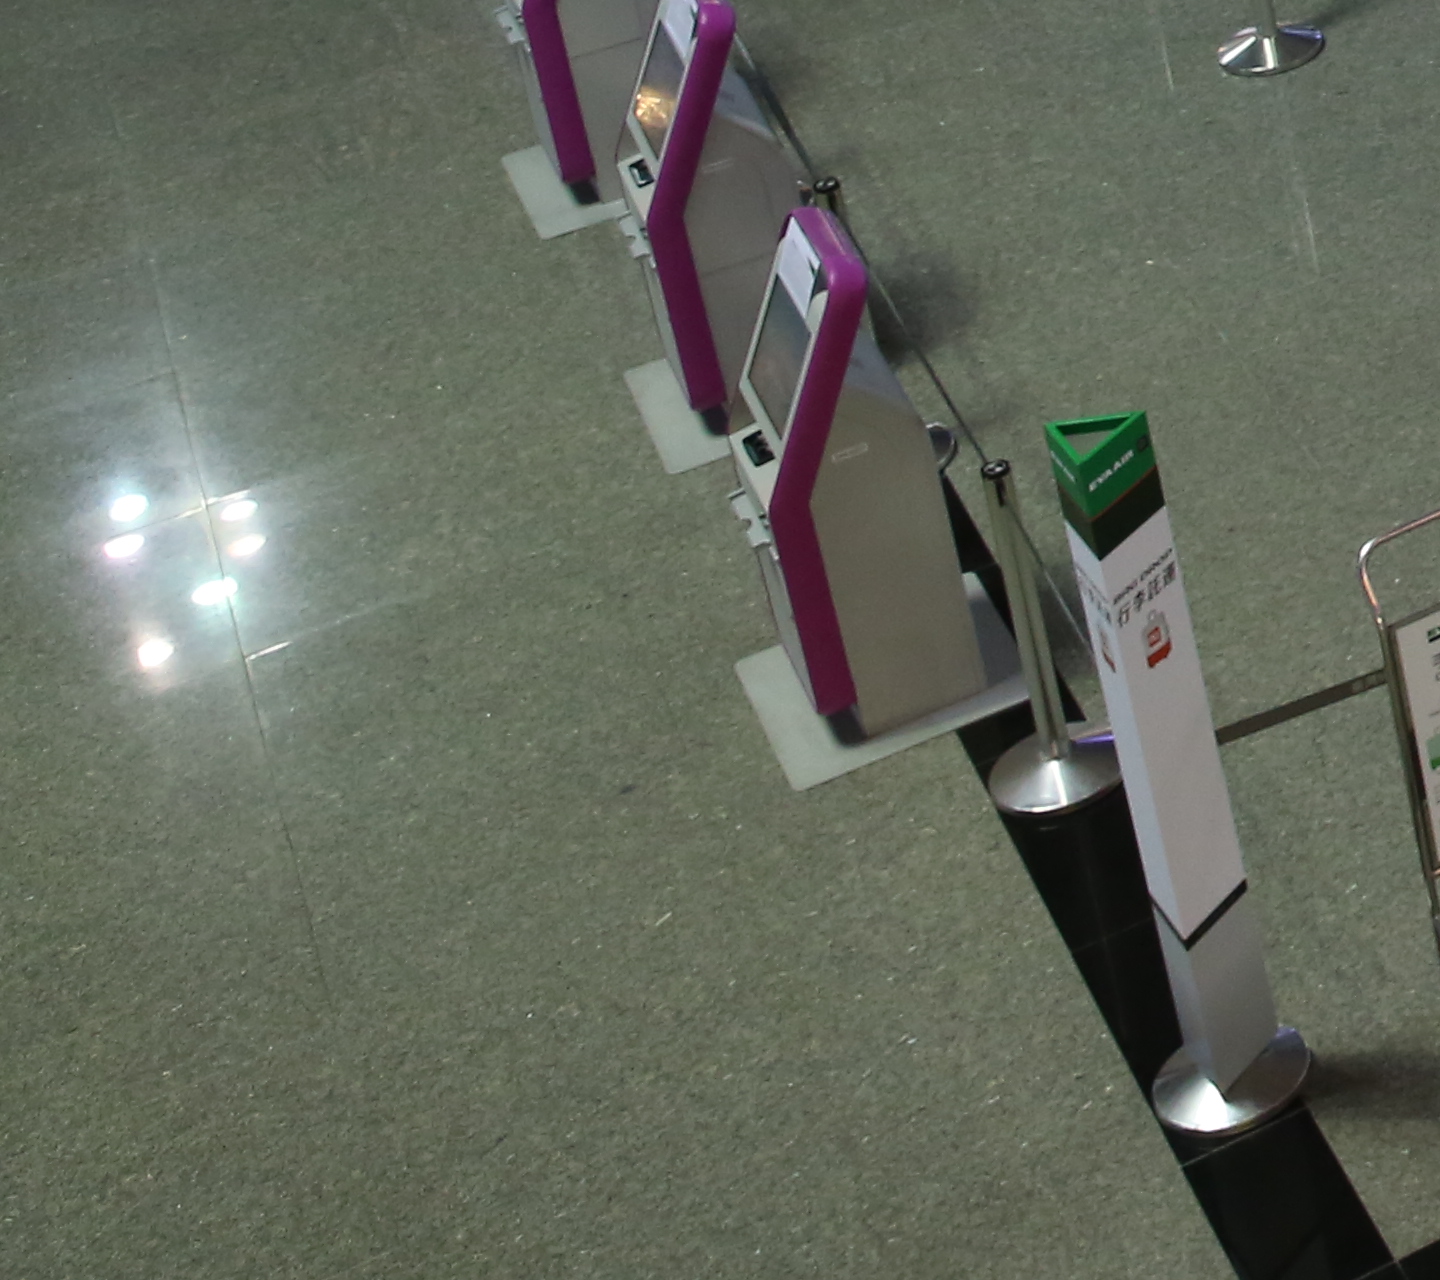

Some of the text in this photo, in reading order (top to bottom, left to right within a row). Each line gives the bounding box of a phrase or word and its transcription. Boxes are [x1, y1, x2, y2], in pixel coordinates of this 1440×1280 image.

[1088, 449, 1134, 493] EVA AIR
[1116, 560, 1176, 628] 行李託運
